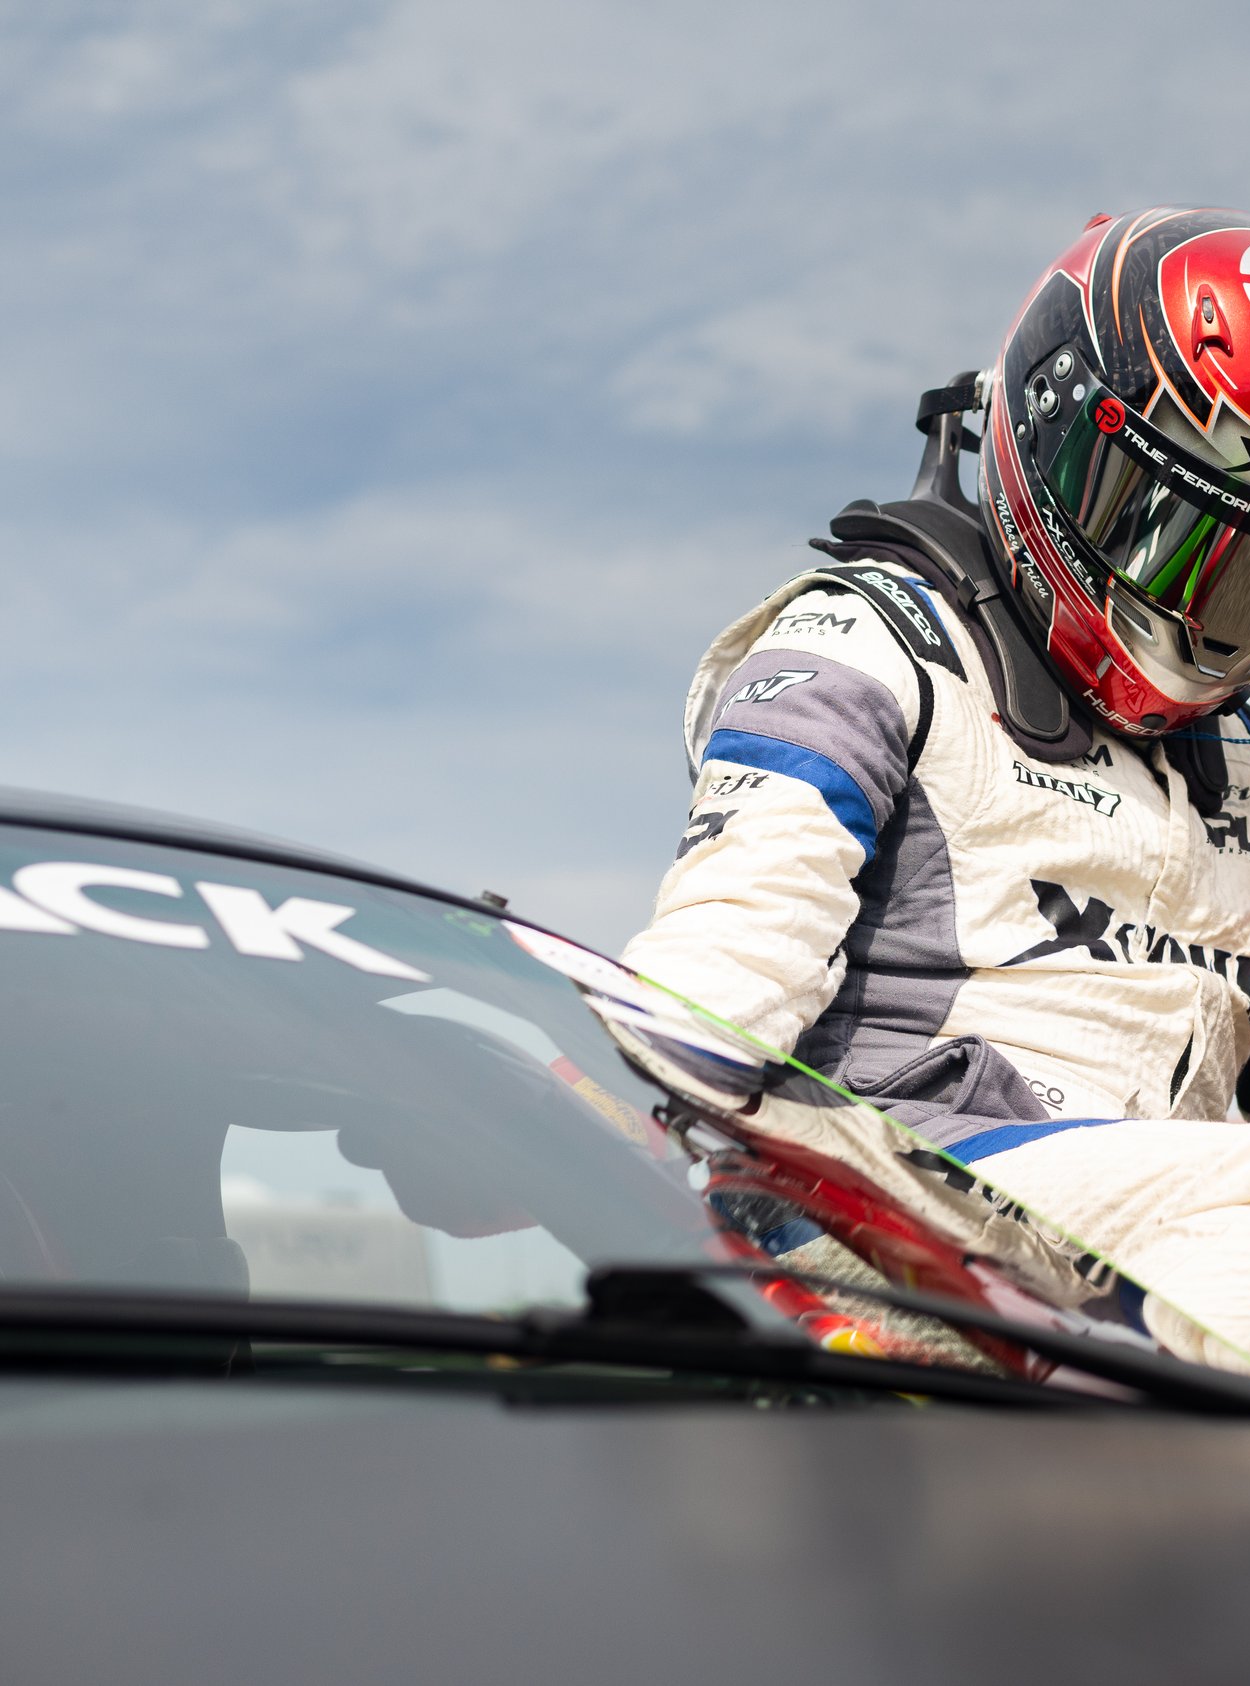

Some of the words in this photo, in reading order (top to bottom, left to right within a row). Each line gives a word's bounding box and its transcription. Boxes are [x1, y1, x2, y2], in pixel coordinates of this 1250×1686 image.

[1124, 424, 1168, 466] TRUE
[772, 612, 857, 635] TPM
[853, 571, 941, 647] sparco
[1013, 760, 1122, 818] TITAN7
